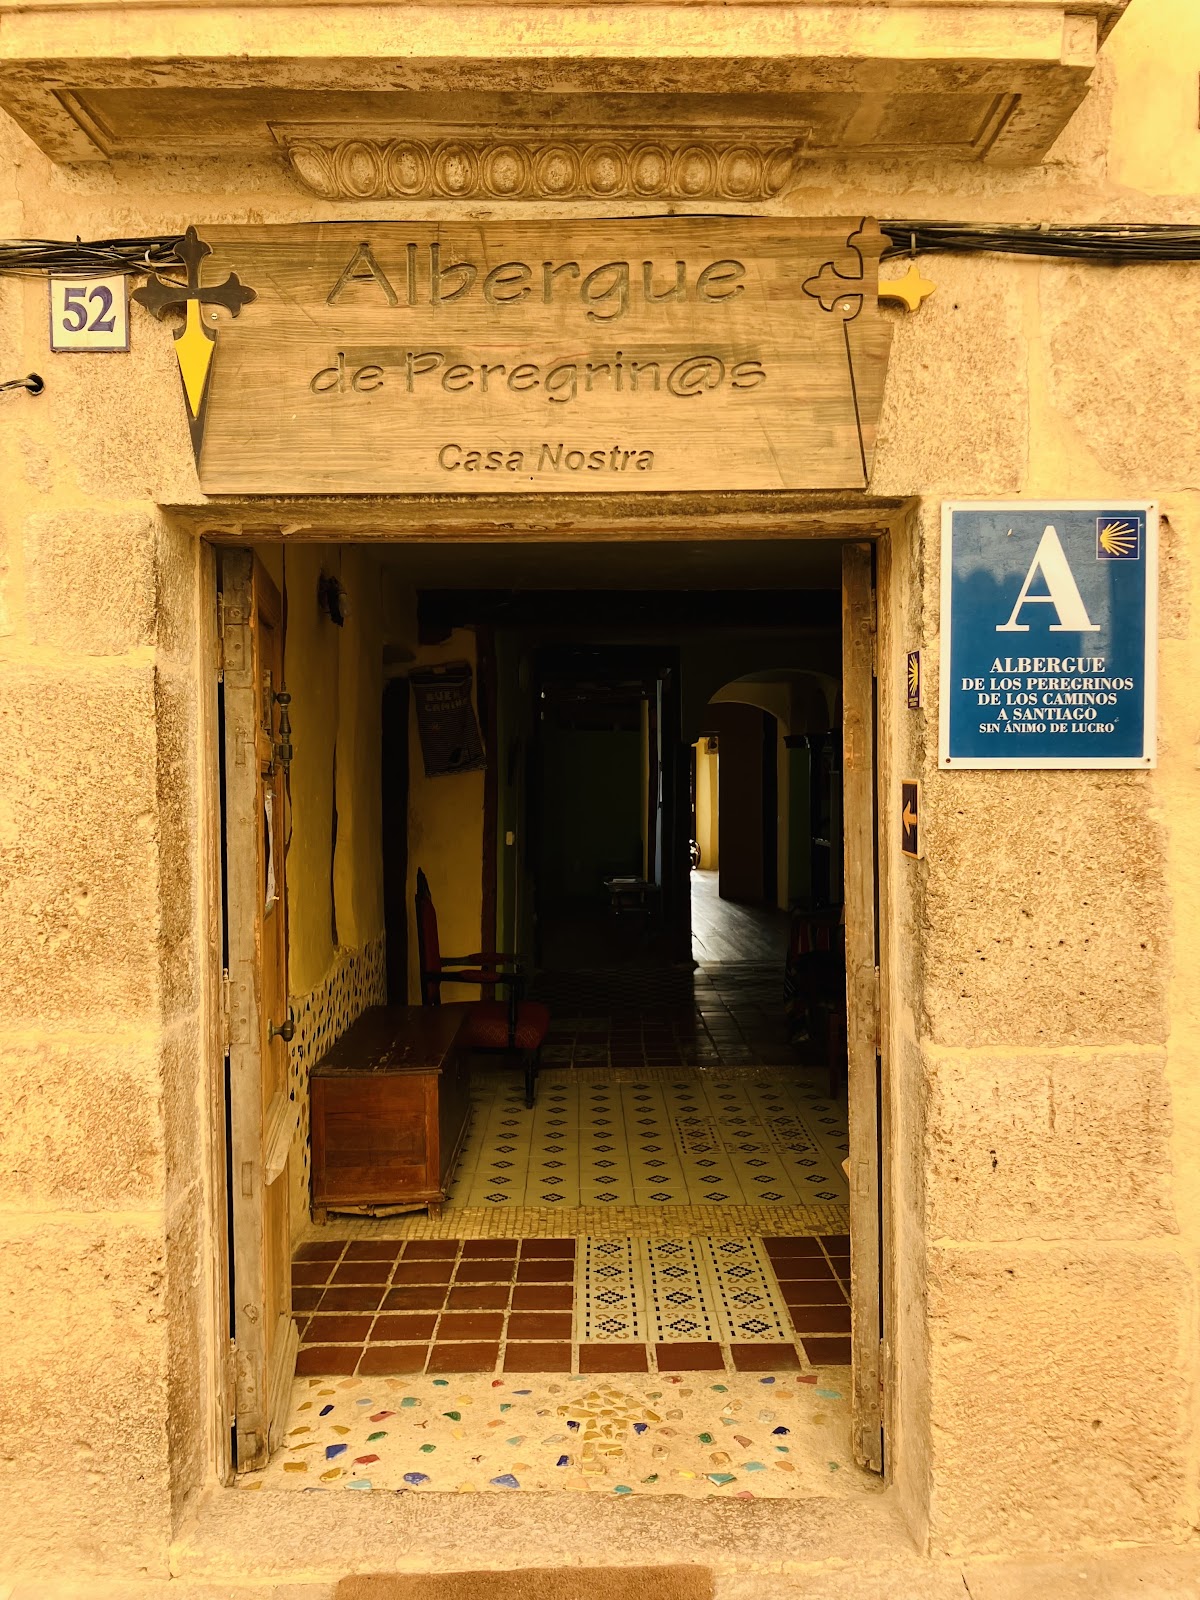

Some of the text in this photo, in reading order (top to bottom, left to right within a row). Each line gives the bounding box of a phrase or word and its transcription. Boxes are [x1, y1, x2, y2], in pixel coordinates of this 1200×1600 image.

[326, 242, 746, 323] Albergue
[62, 286, 116, 333] 52
[310, 350, 767, 403] de Peregrin@s
[438, 443, 655, 472] Casa Nostra
[995, 525, 1101, 632] A
[989, 657, 1106, 673] ALBERGUE
[961, 677, 1134, 691] DE LOS PEREGRINOS
[977, 693, 1118, 706] DE LOS CAMINOS
[997, 707, 1098, 721] A SANTIAGO
[979, 720, 1115, 733] SIN ÁNIMO DE LUCRO
